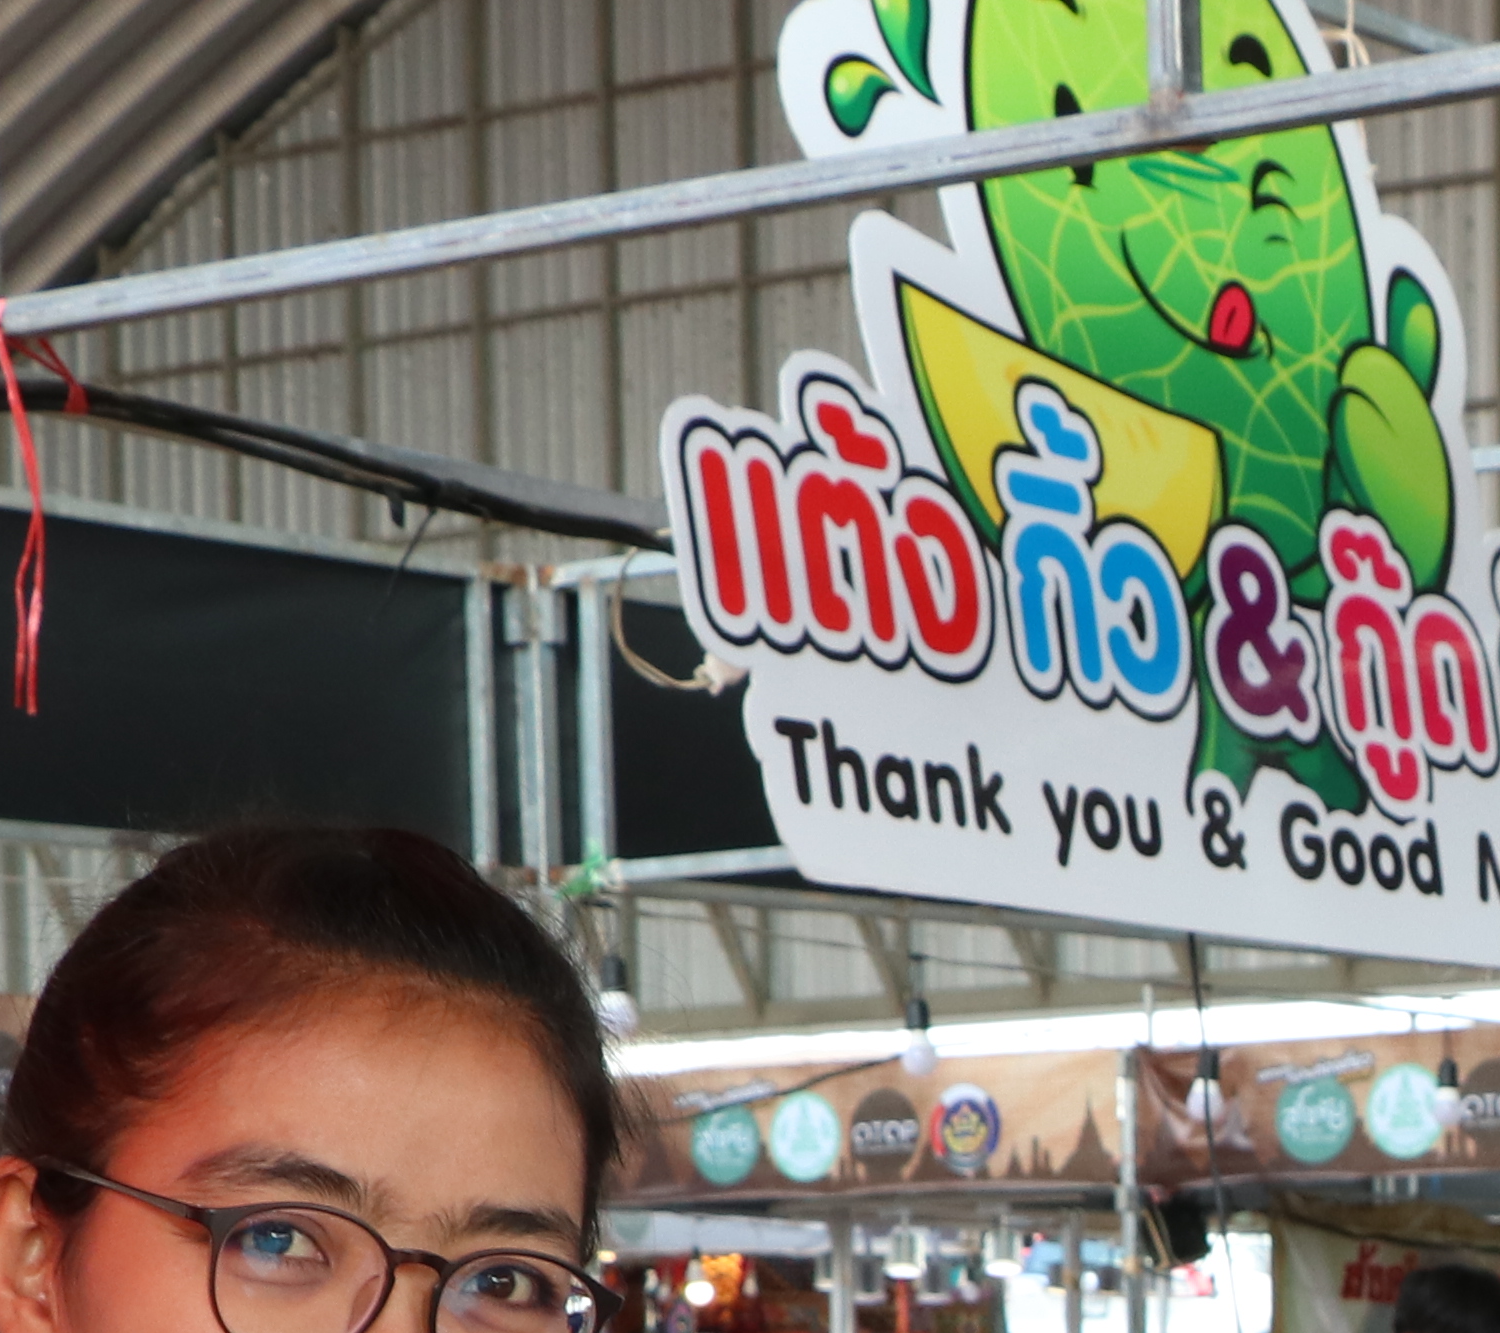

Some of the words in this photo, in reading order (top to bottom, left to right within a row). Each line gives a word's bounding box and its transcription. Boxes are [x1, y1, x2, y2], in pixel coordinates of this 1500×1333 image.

[1009, 402, 1180, 695] กิ้ว
[1217, 542, 1310, 724] &
[1330, 527, 1489, 801] กู๊ด
[775, 718, 1012, 835] Thank
[1040, 778, 1162, 865] you
[1202, 788, 1246, 870] &
[1280, 802, 1443, 896] Good
